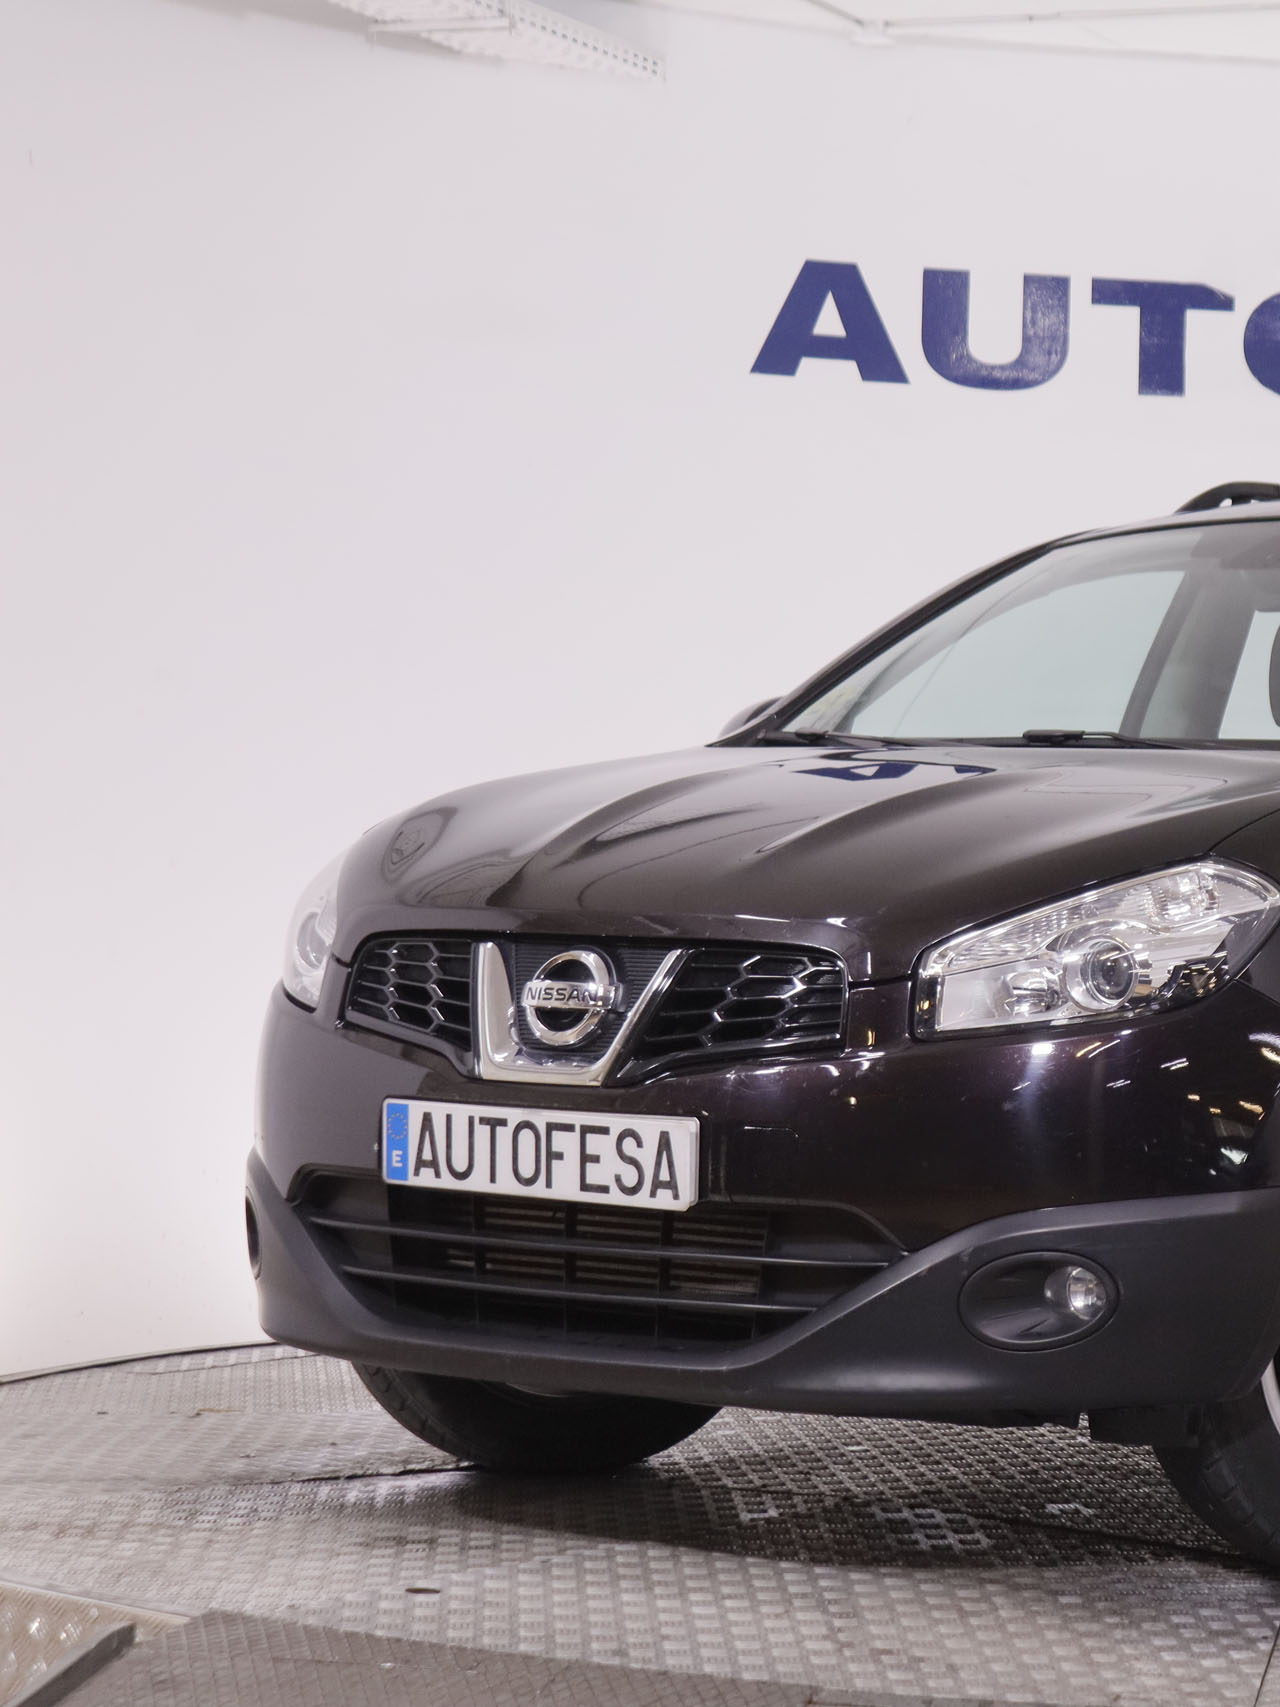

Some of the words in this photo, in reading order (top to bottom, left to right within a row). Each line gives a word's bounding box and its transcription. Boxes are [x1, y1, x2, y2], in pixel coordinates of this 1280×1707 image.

[526, 986, 598, 1004] NISSAN
[391, 1150, 403, 1168] E
[413, 1111, 681, 1201] AUTOFESA
